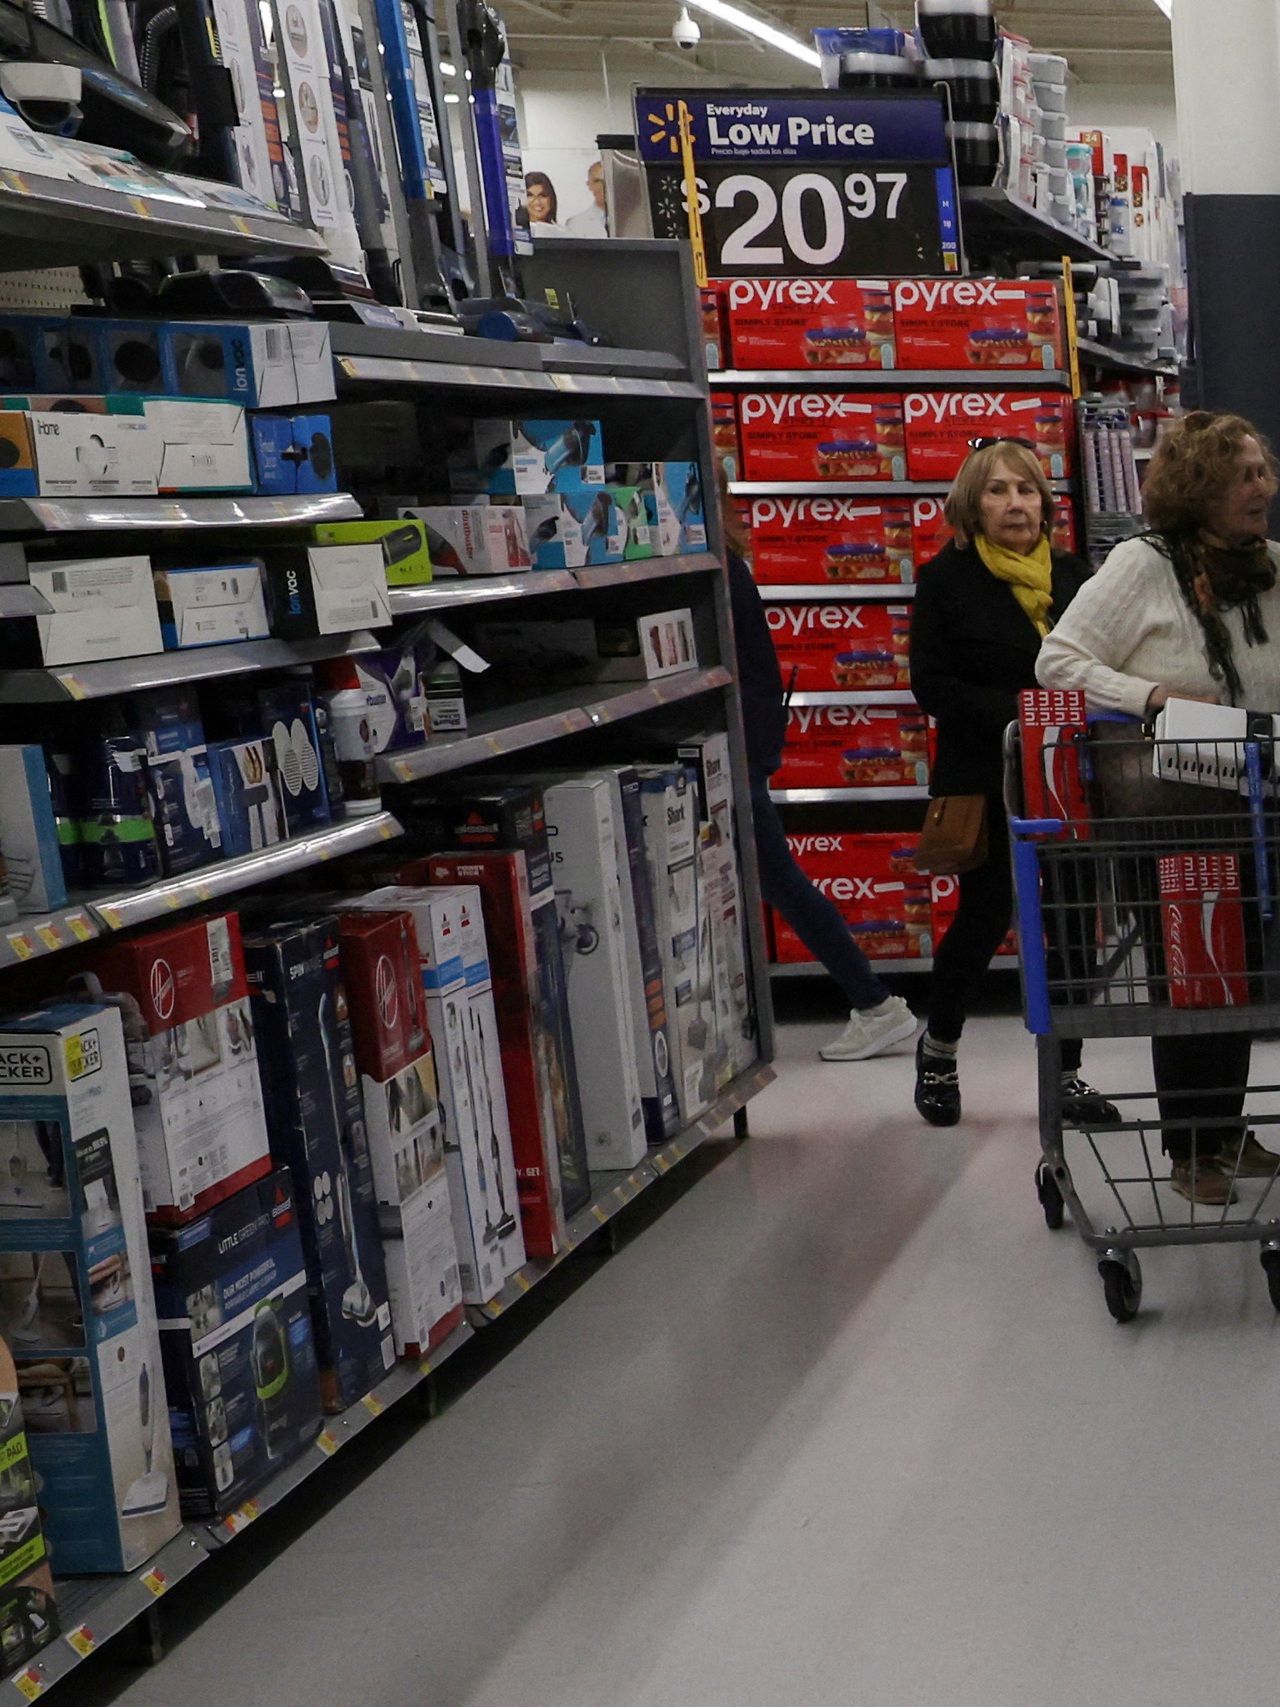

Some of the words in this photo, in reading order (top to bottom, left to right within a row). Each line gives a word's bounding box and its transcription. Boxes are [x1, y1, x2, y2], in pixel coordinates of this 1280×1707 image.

[706, 103, 768, 118] Everyday
[708, 116, 780, 146] Low
[787, 115, 875, 146] Price
[729, 279, 836, 311] pyrex
[895, 281, 998, 312] pyrex
[741, 393, 848, 424] pyrex
[904, 392, 1008, 423] pyrex
[37, 419, 60, 436] iHome
[752, 498, 855, 529] pyrex
[667, 803, 685, 825] Shark
[217, 1232, 239, 1254] LITTLE
